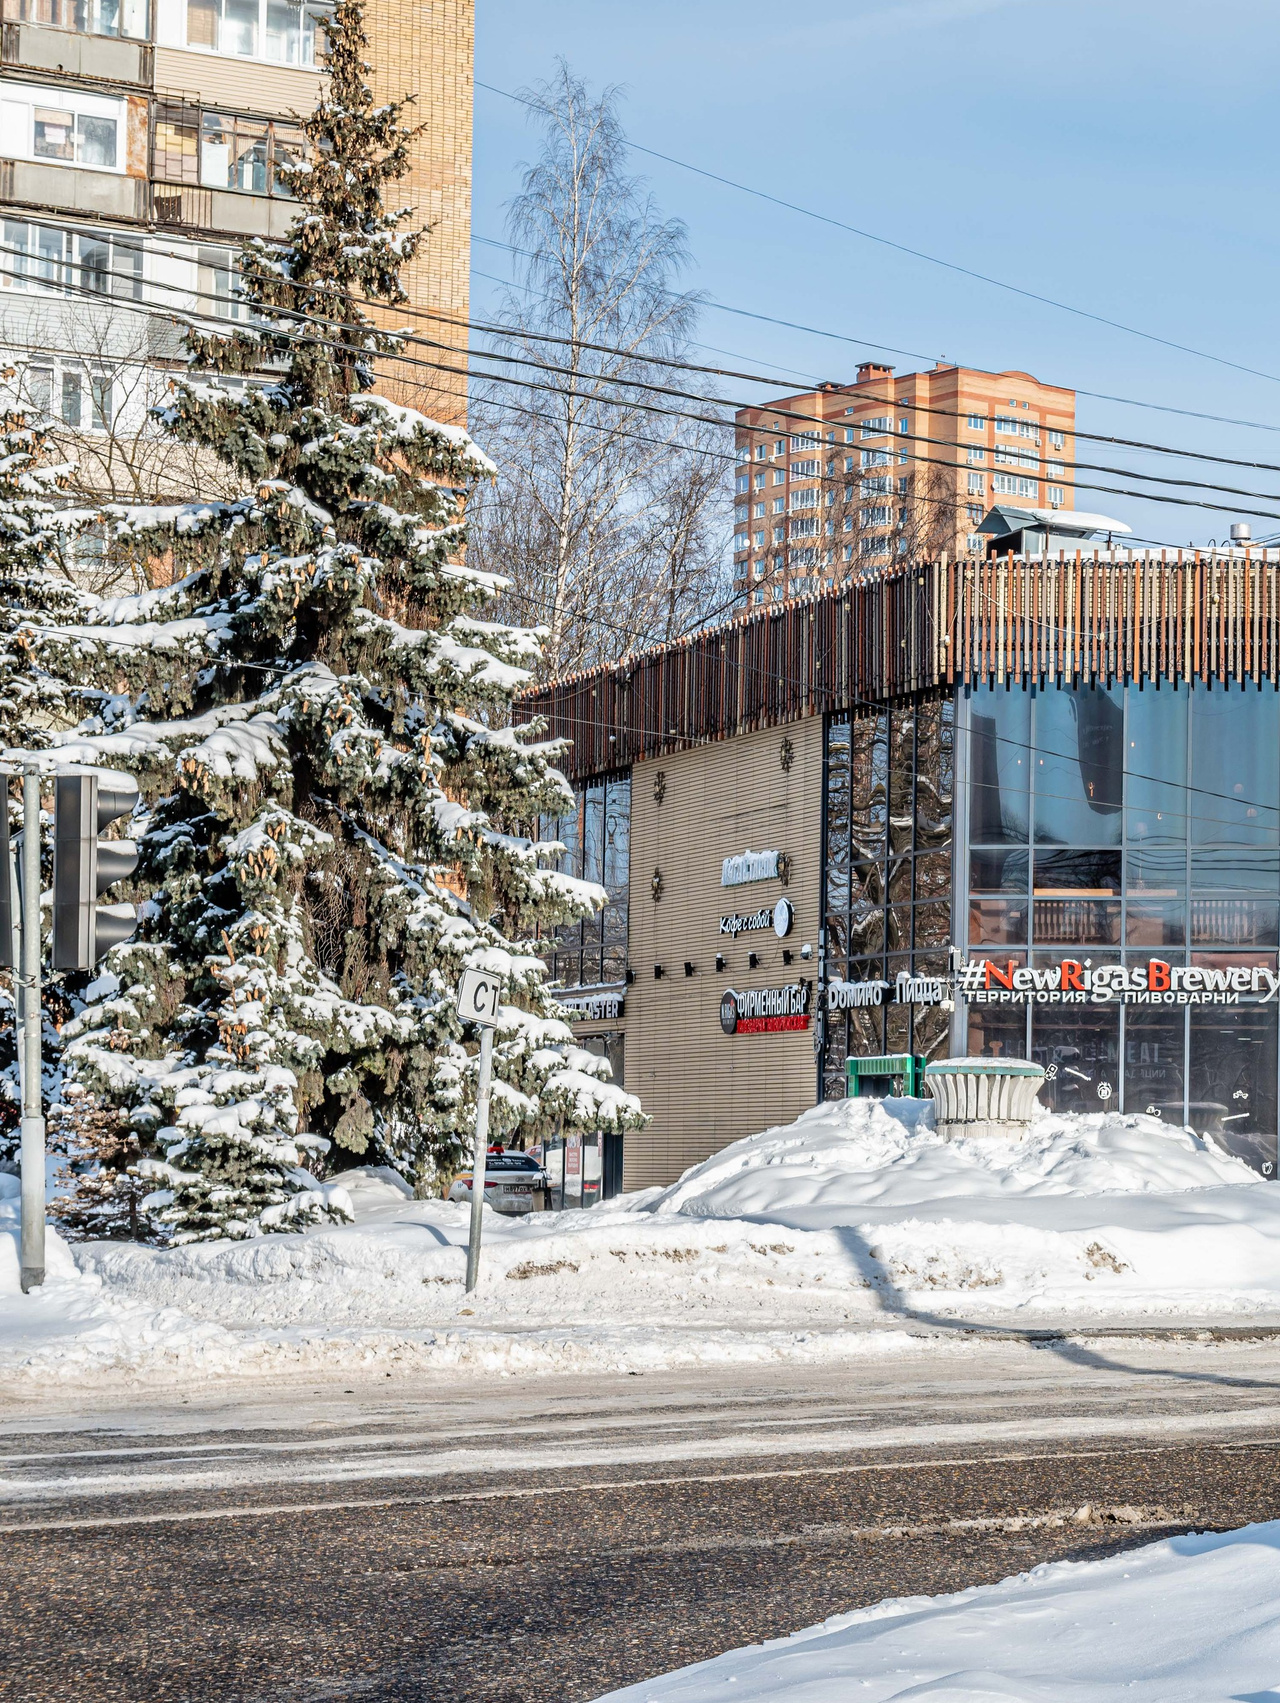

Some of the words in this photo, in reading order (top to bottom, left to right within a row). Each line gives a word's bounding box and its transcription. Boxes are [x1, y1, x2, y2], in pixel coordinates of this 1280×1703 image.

[720, 913, 742, 938] Кофе
[748, 909, 770, 930] собой
[737, 988, 790, 1017] ФИРМЕННЫЙ
[790, 986, 807, 1014] БАР
[896, 979, 943, 1006] Пицца
[964, 990, 1086, 1003] ТЕРРИТОРИЯ
[1124, 991, 1240, 1004] ПИВОВАРНИ
